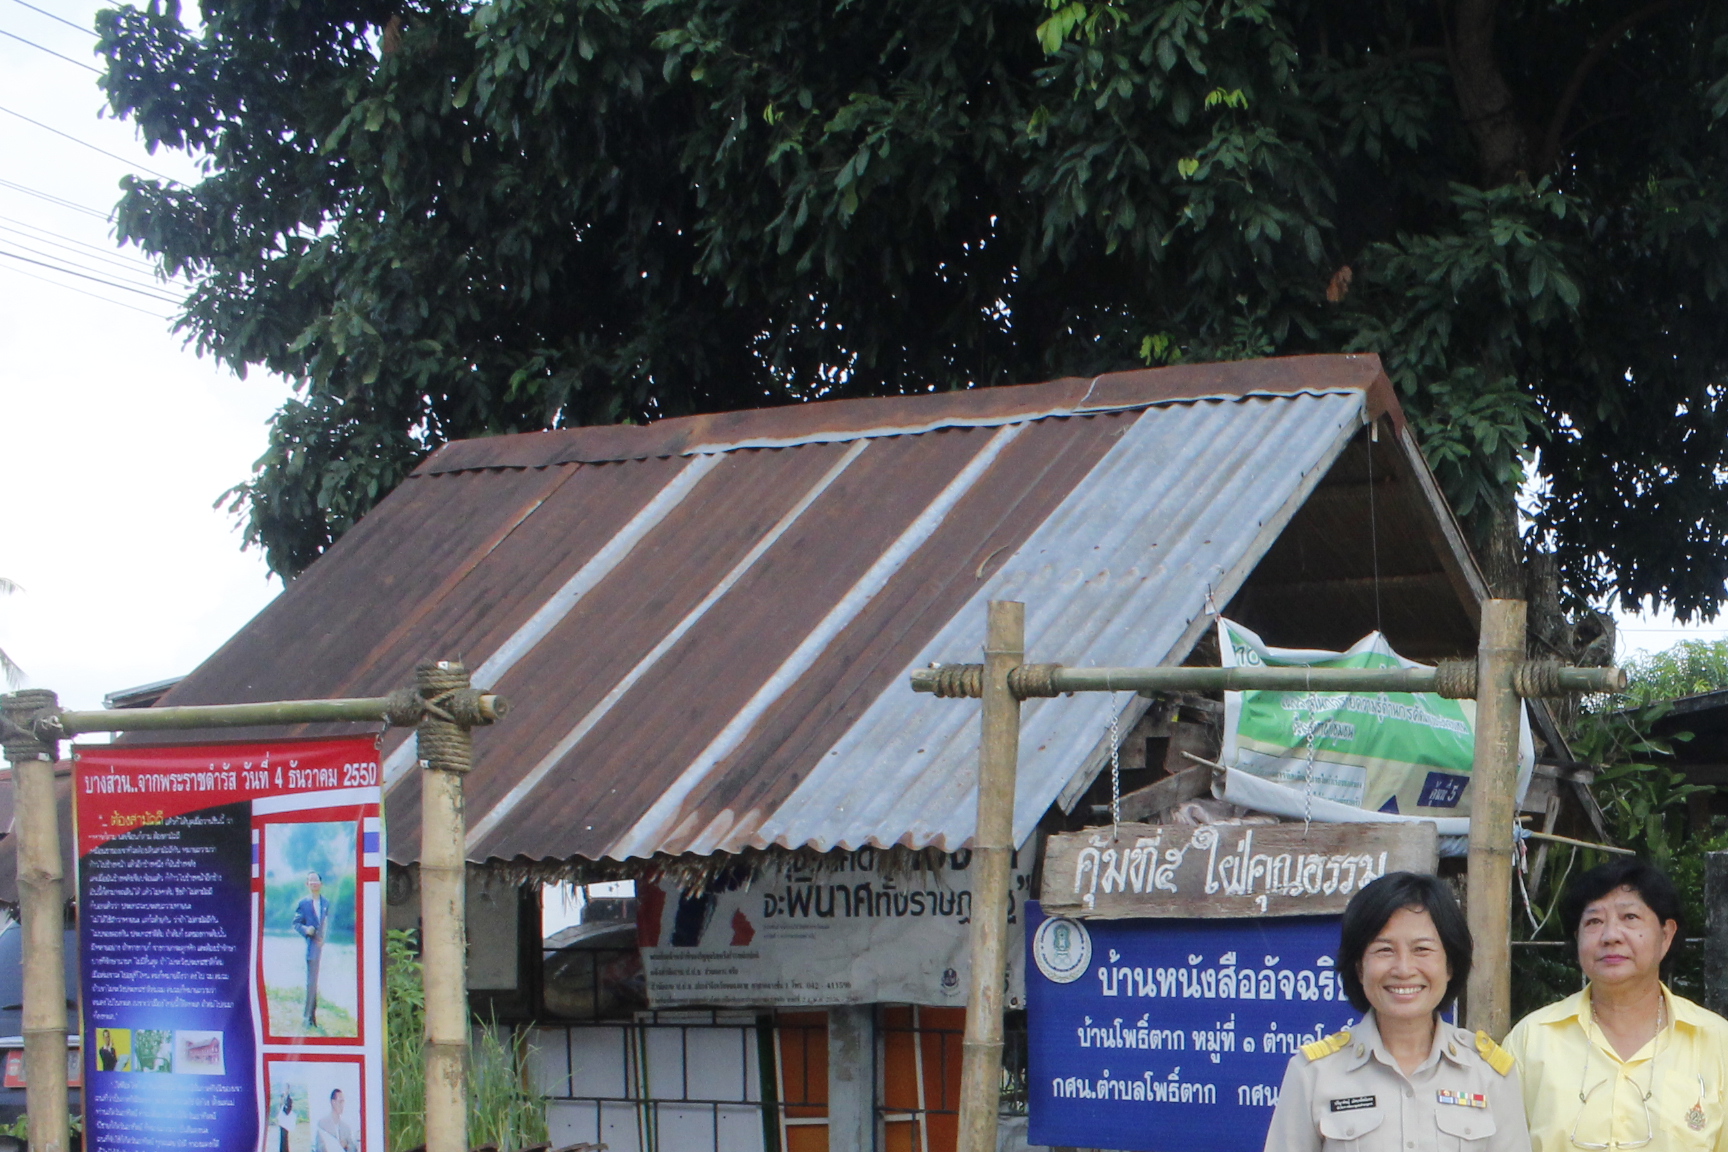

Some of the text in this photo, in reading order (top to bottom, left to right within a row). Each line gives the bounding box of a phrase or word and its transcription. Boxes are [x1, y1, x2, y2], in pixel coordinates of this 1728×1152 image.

[242, 752, 270, 789] วันที่
[275, 767, 283, 788] 4
[288, 760, 338, 788] ธันวาคม
[343, 762, 378, 787] 2550
[1077, 1013, 1185, 1049] บ้านโพธิ์ตาก
[1192, 1013, 1236, 1063] หมู่ที่
[1243, 1037, 1256, 1053] ๑
[1052, 1066, 1216, 1104] กศน.ตำบลโพธิ์ตาก
